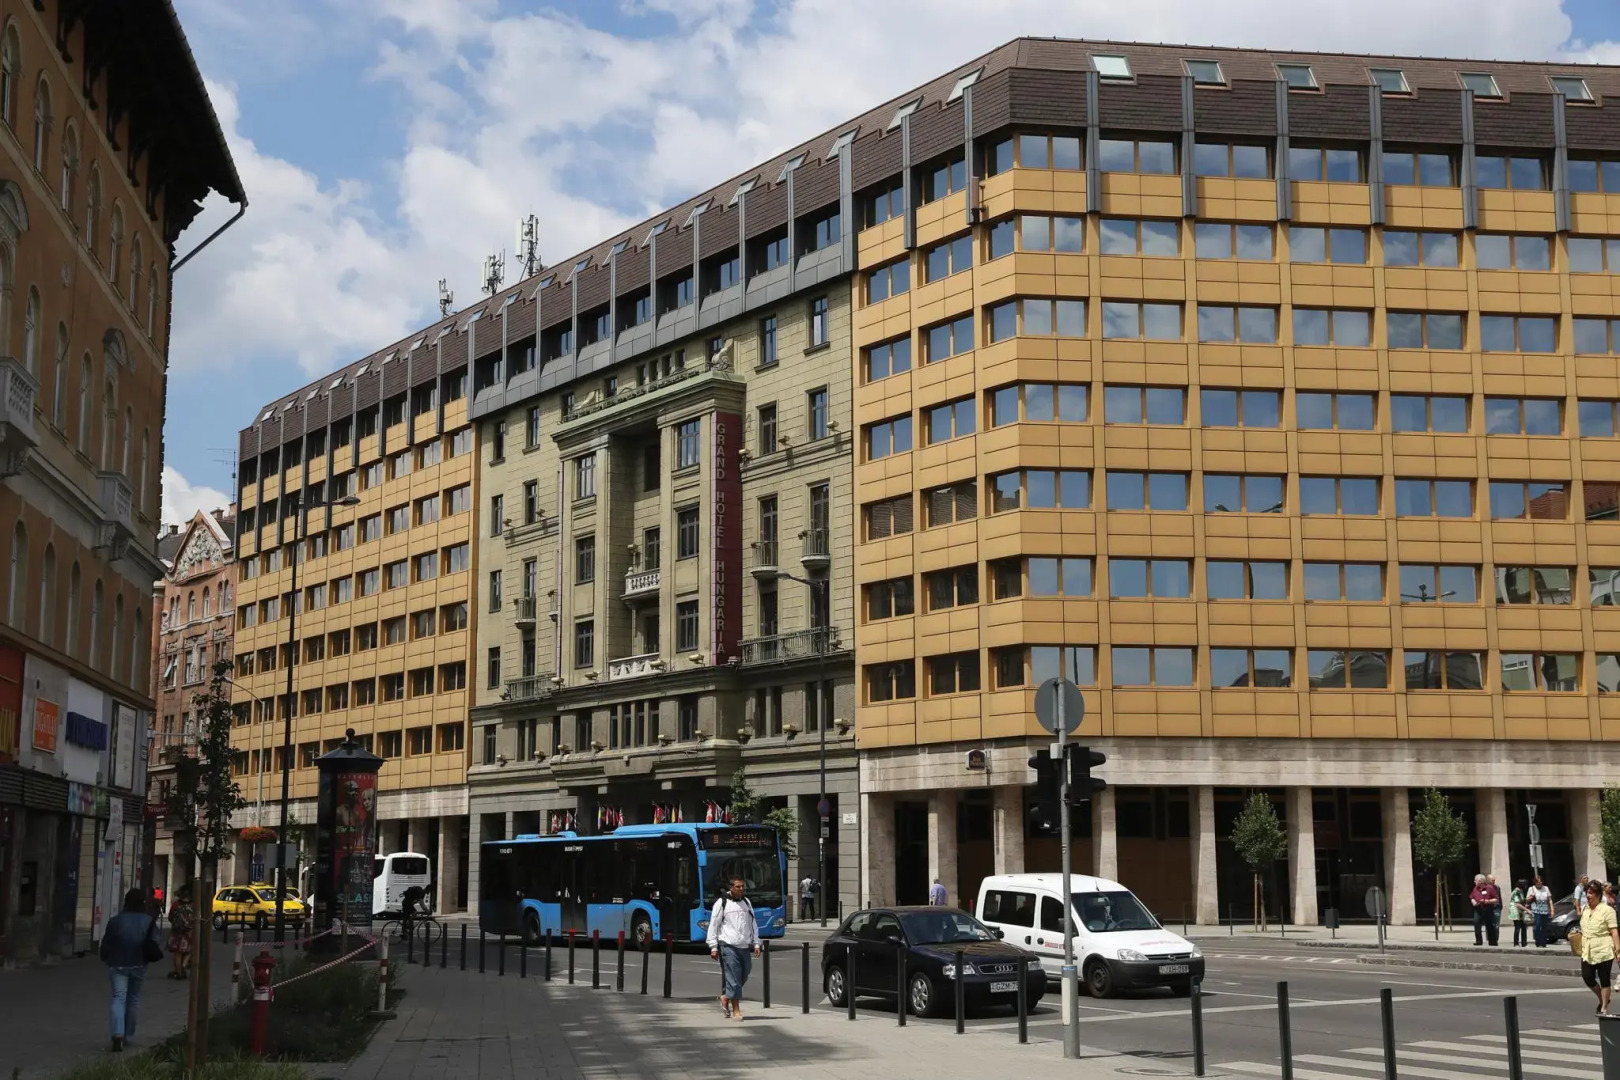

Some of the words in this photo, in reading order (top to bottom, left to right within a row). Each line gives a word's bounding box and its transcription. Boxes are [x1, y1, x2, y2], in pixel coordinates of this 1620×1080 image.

[716, 422, 725, 480] GRAND
[716, 491, 725, 549] HOTEL
[716, 560, 725, 654] HUNGARIA
